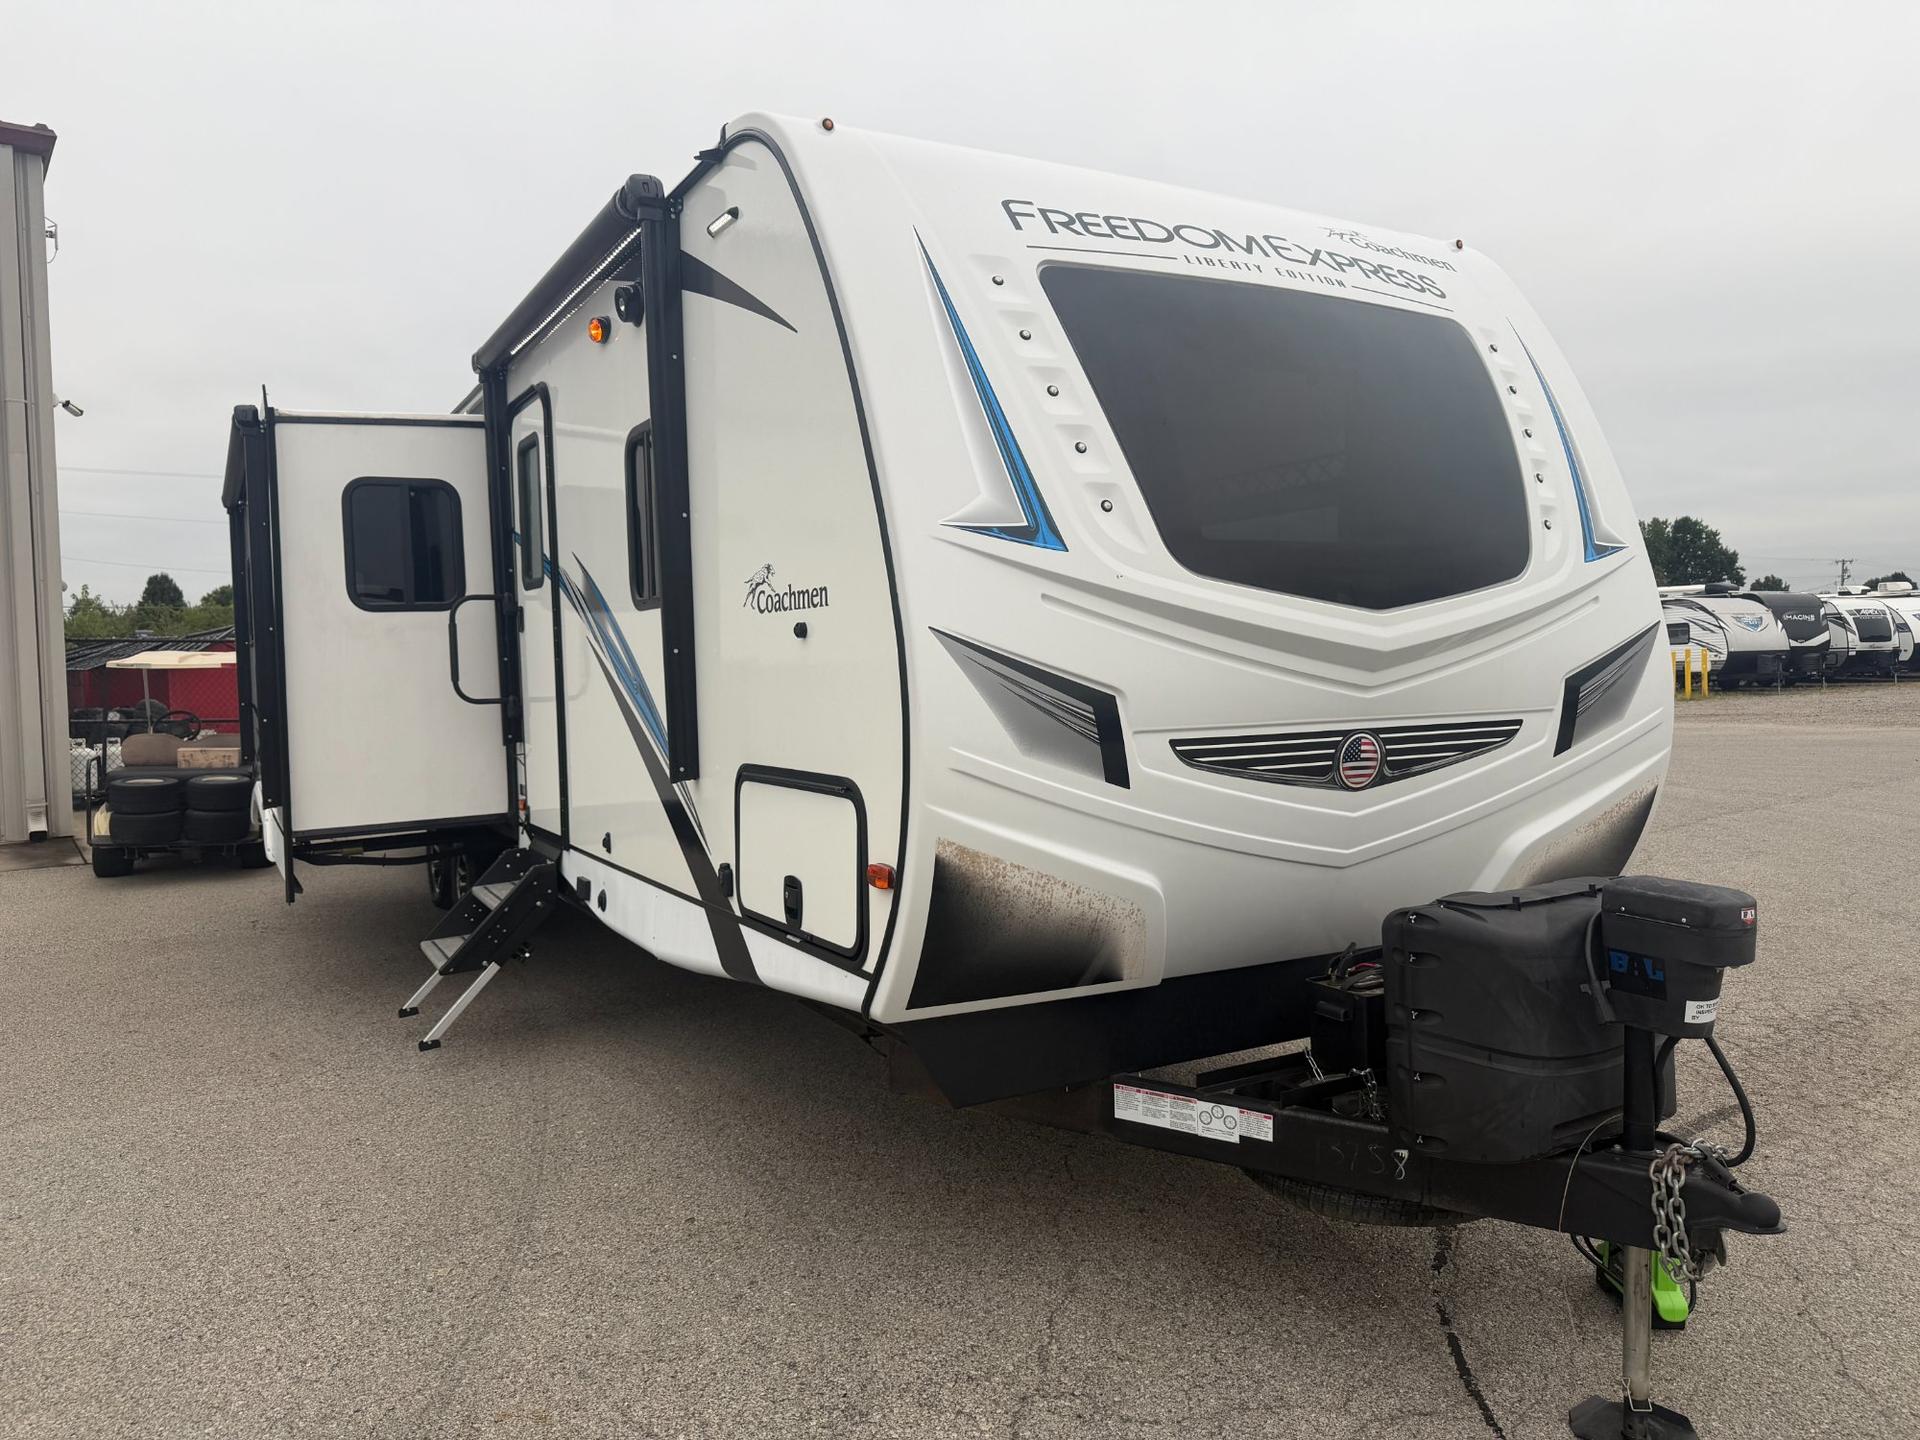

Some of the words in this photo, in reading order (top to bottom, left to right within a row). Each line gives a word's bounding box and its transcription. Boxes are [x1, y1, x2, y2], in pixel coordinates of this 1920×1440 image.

[1183, 254, 1264, 273] LIBERTY
[1275, 267, 1347, 288] EDITION
[1348, 237, 1457, 273] Coachmen
[757, 583, 829, 614] Coachmen
